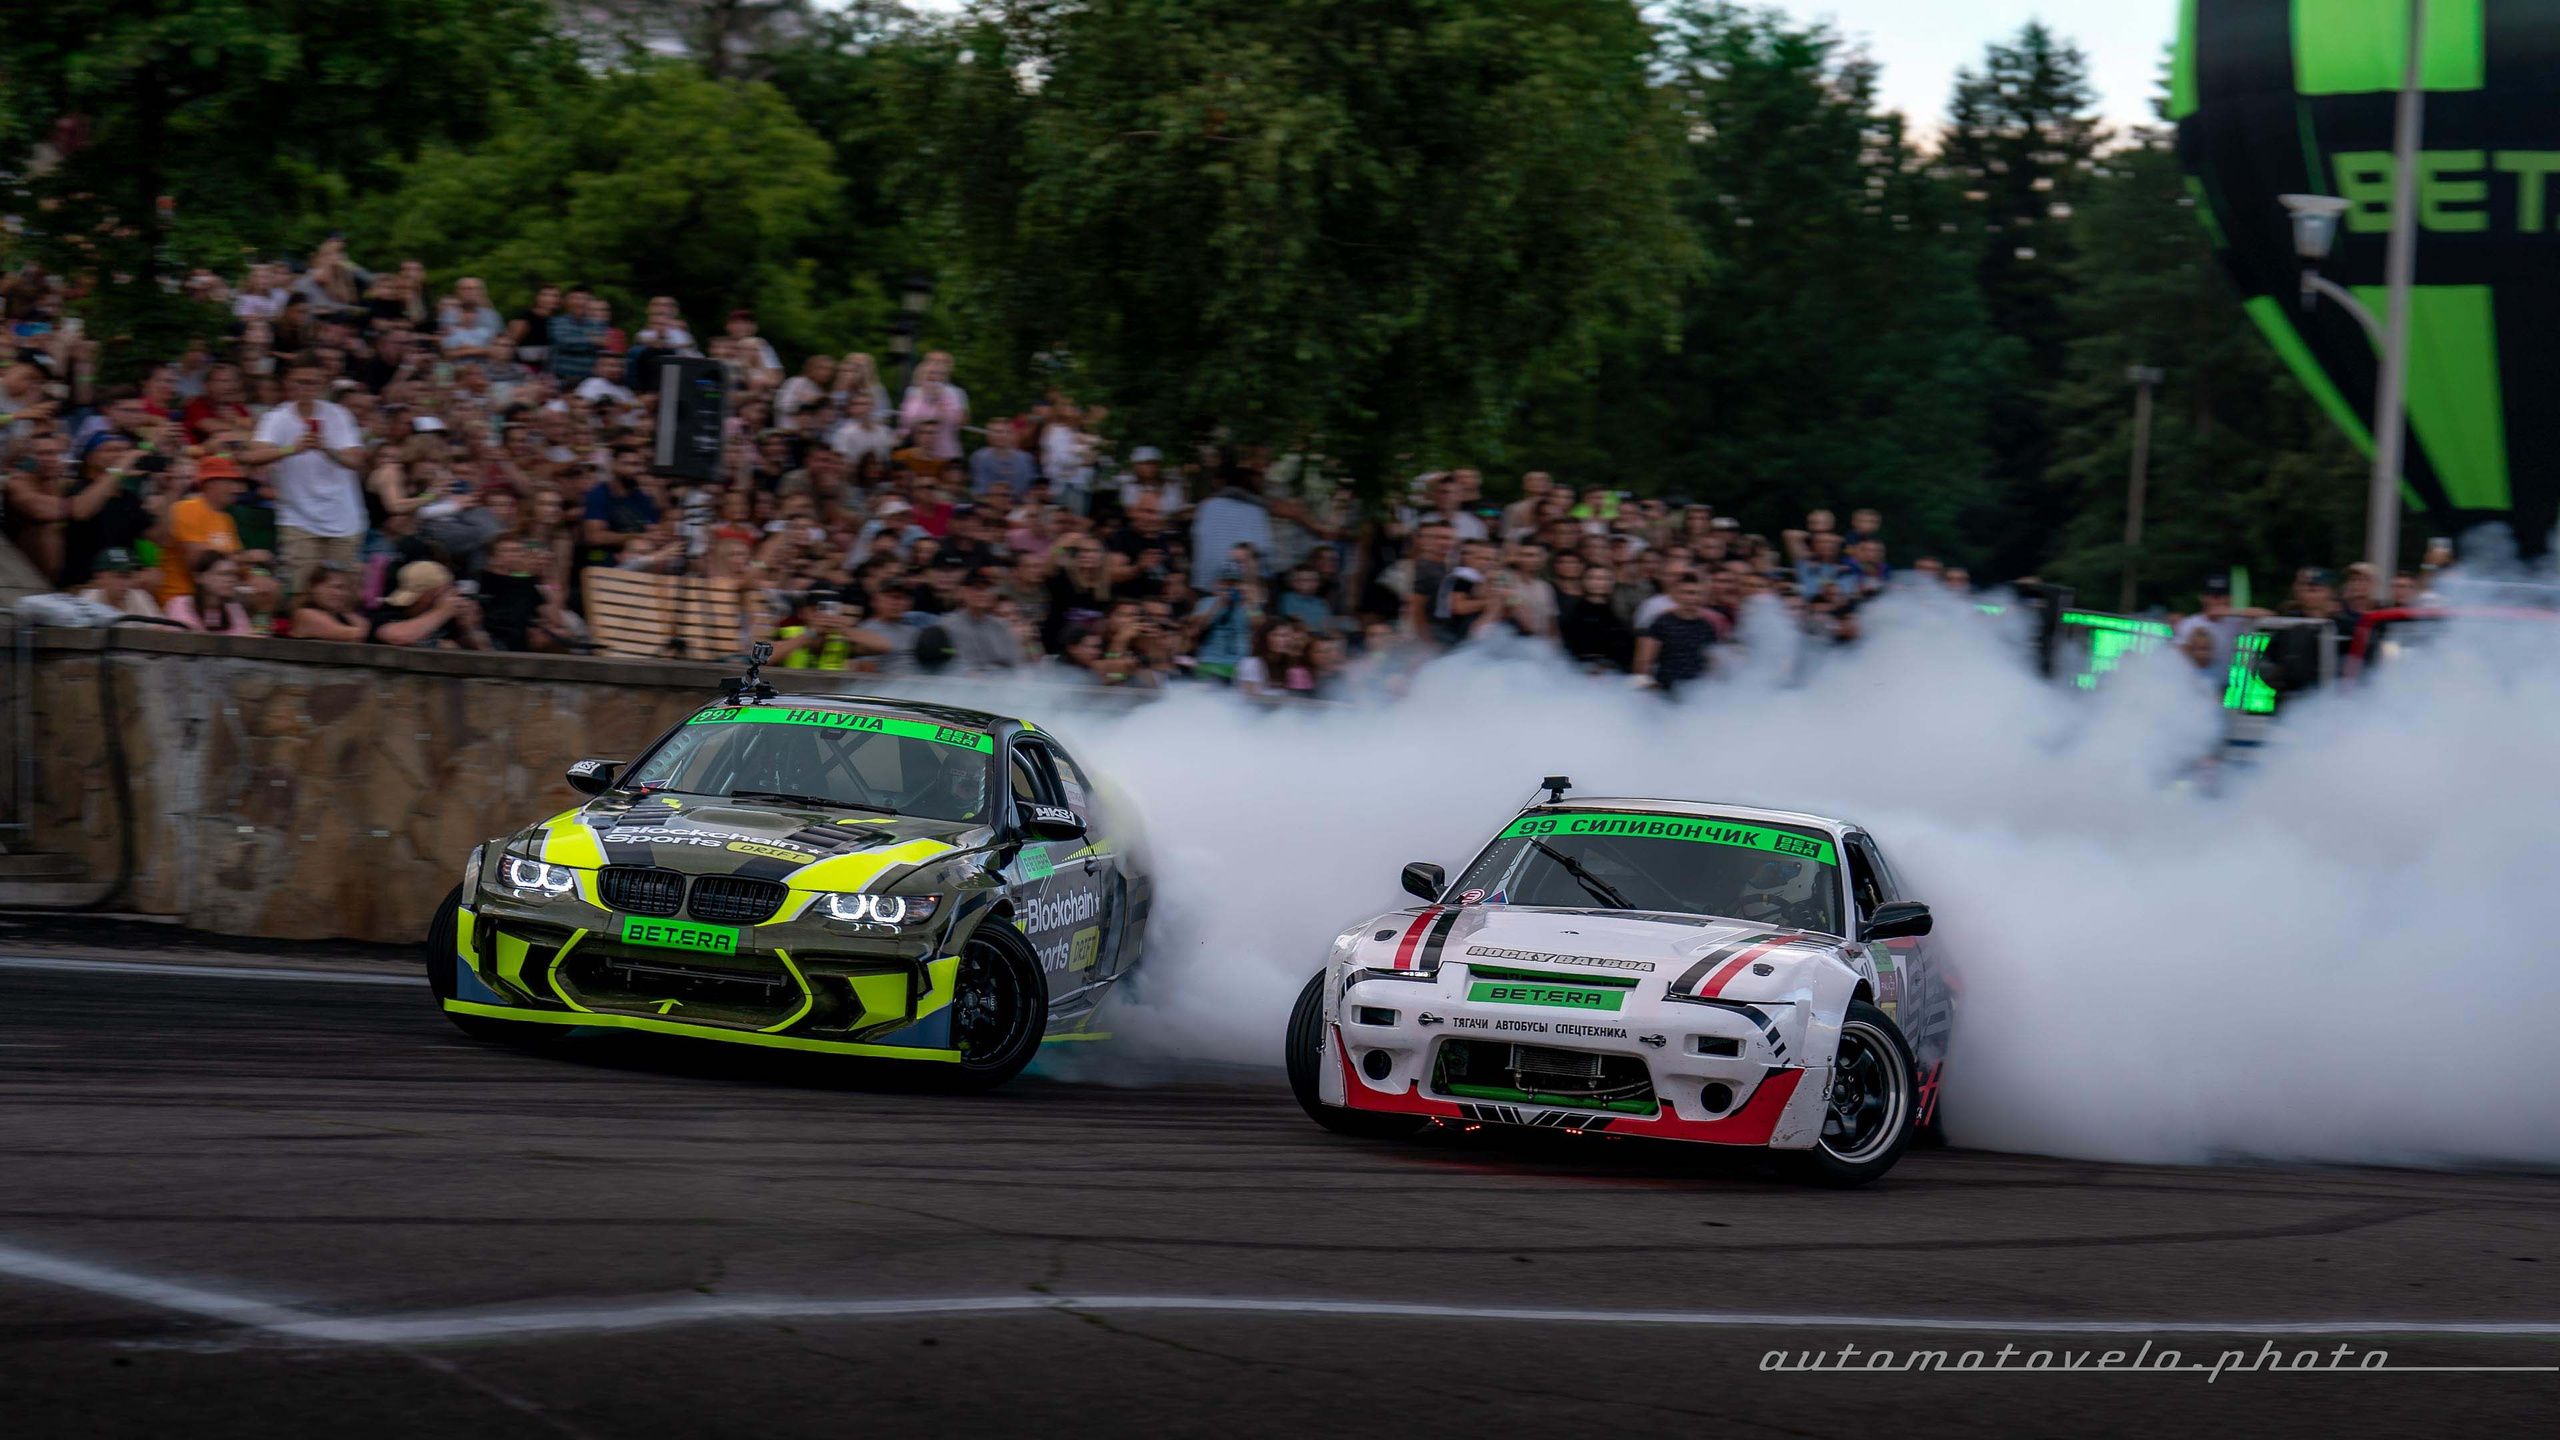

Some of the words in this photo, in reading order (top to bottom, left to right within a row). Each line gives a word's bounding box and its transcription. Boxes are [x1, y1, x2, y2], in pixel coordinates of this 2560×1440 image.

[2332, 150, 2560, 232] BET
[700, 708, 738, 721] 999
[786, 710, 884, 730] НАГУЛА
[611, 826, 800, 851] Blockchain
[1518, 819, 1558, 836] 99
[1570, 819, 1761, 847] СИЛИВОНЧИК
[603, 834, 722, 848] Sports
[740, 844, 805, 861] DRIFT
[1027, 886, 1094, 934] Blockchain
[629, 925, 730, 950] BET.ERA
[1466, 945, 1553, 962] ROCKY
[1553, 953, 1656, 972] BALBOA
[1490, 987, 1602, 1005] BET.ERA
[1453, 1017, 1488, 1029] ТЯГАЧИ
[1495, 1020, 1548, 1033] АВТОБУСЫ
[1555, 1024, 1628, 1039] СПЕЦТЕХНИКА
